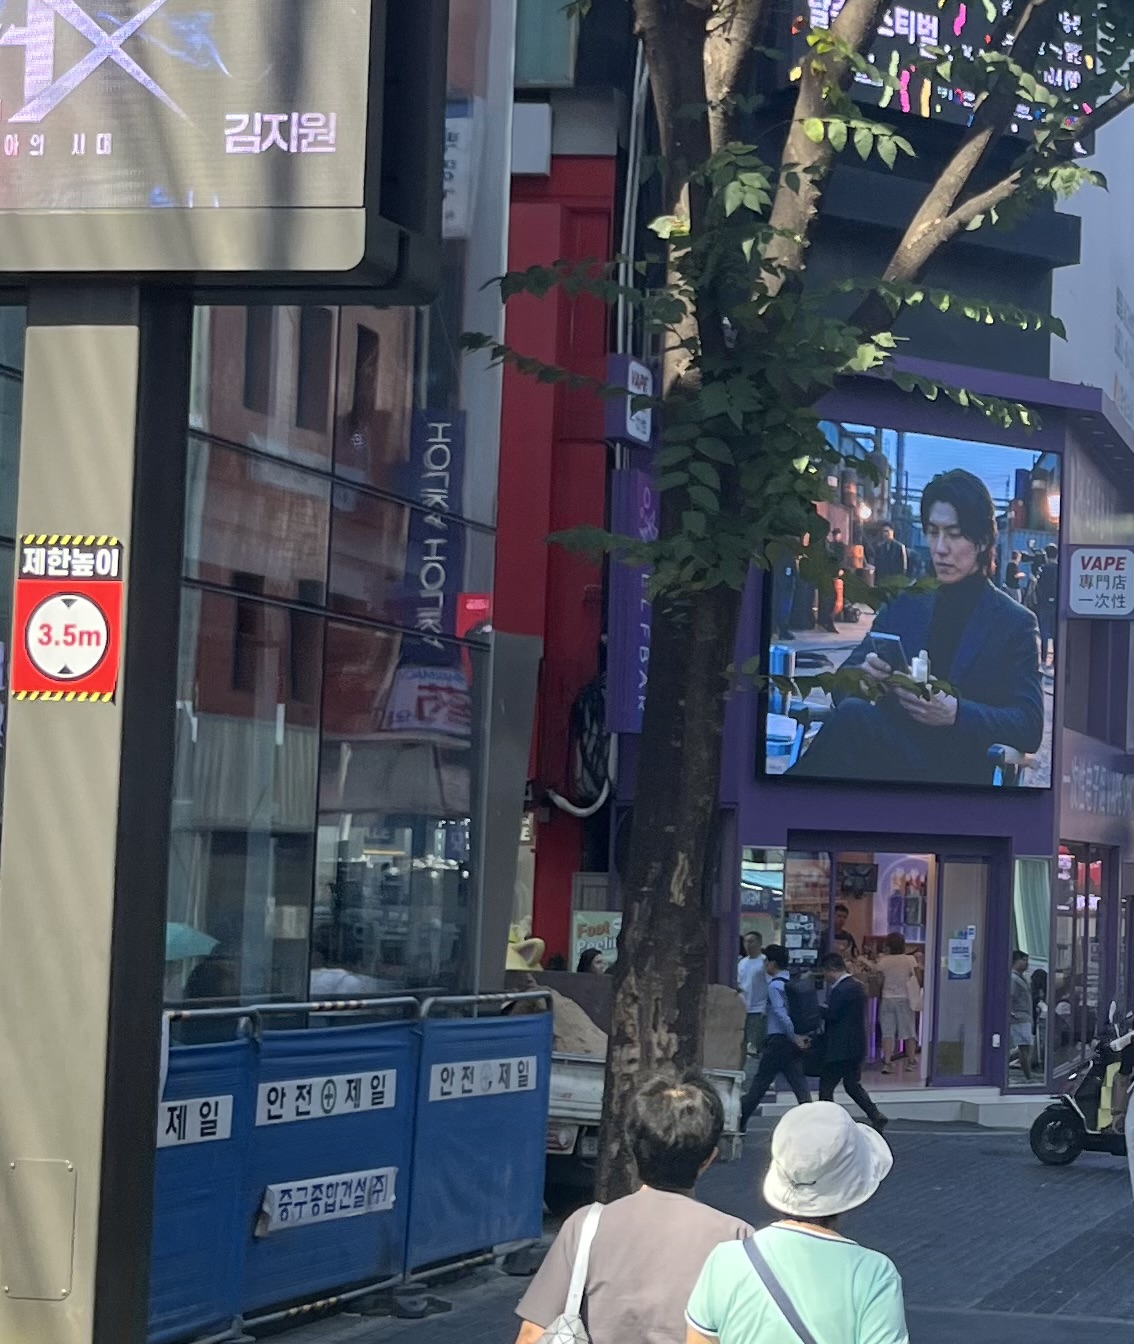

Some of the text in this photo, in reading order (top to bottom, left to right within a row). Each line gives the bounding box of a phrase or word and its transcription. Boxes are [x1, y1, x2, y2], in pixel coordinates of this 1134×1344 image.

[71, 132, 113, 155] 시대
[224, 111, 337, 154] 김지원
[22, 547, 119, 577] 제한높이
[1080, 555, 1126, 571] VAPE
[1079, 574, 1127, 591] 專門店
[1078, 593, 1127, 609] 一次性
[37, 623, 101, 647] 3.5m
[576, 921, 611, 939] Foot
[439, 1060, 530, 1097] 안전 제일
[267, 1074, 387, 1121] 안전 제일
[165, 1100, 219, 1141] 제일
